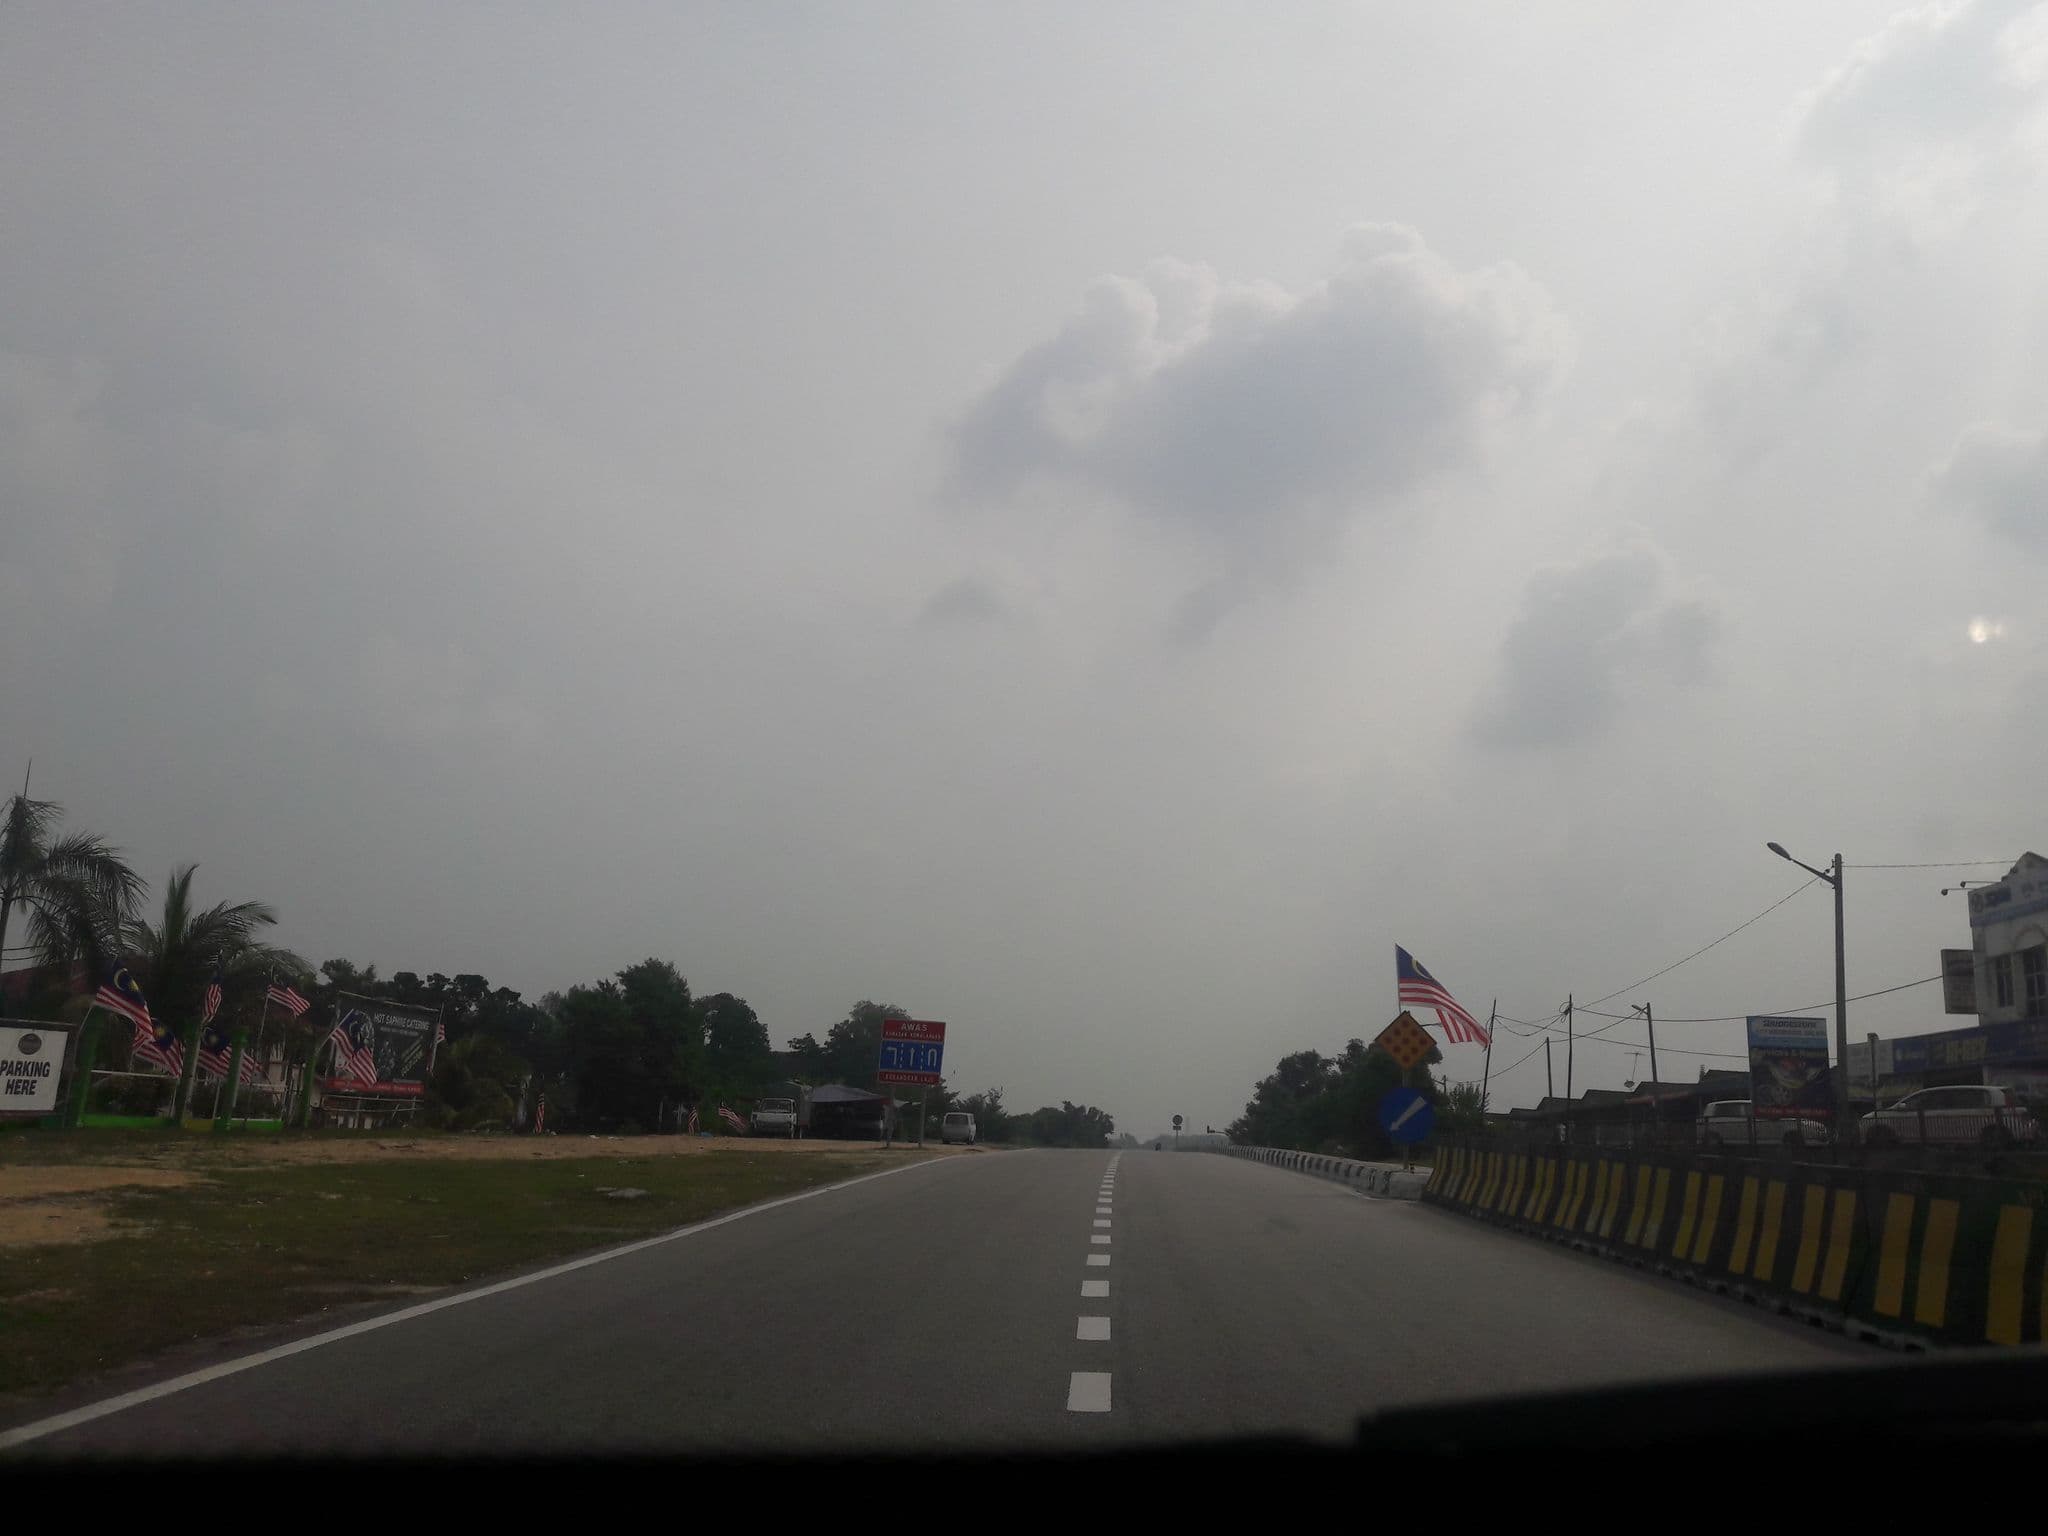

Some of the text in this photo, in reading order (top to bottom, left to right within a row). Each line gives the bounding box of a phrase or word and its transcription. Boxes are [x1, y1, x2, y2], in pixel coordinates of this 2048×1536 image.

[901, 1023, 929, 1032] AWAS
[0, 1060, 50, 1077] PARKING
[5, 1079, 37, 1095] HERE
